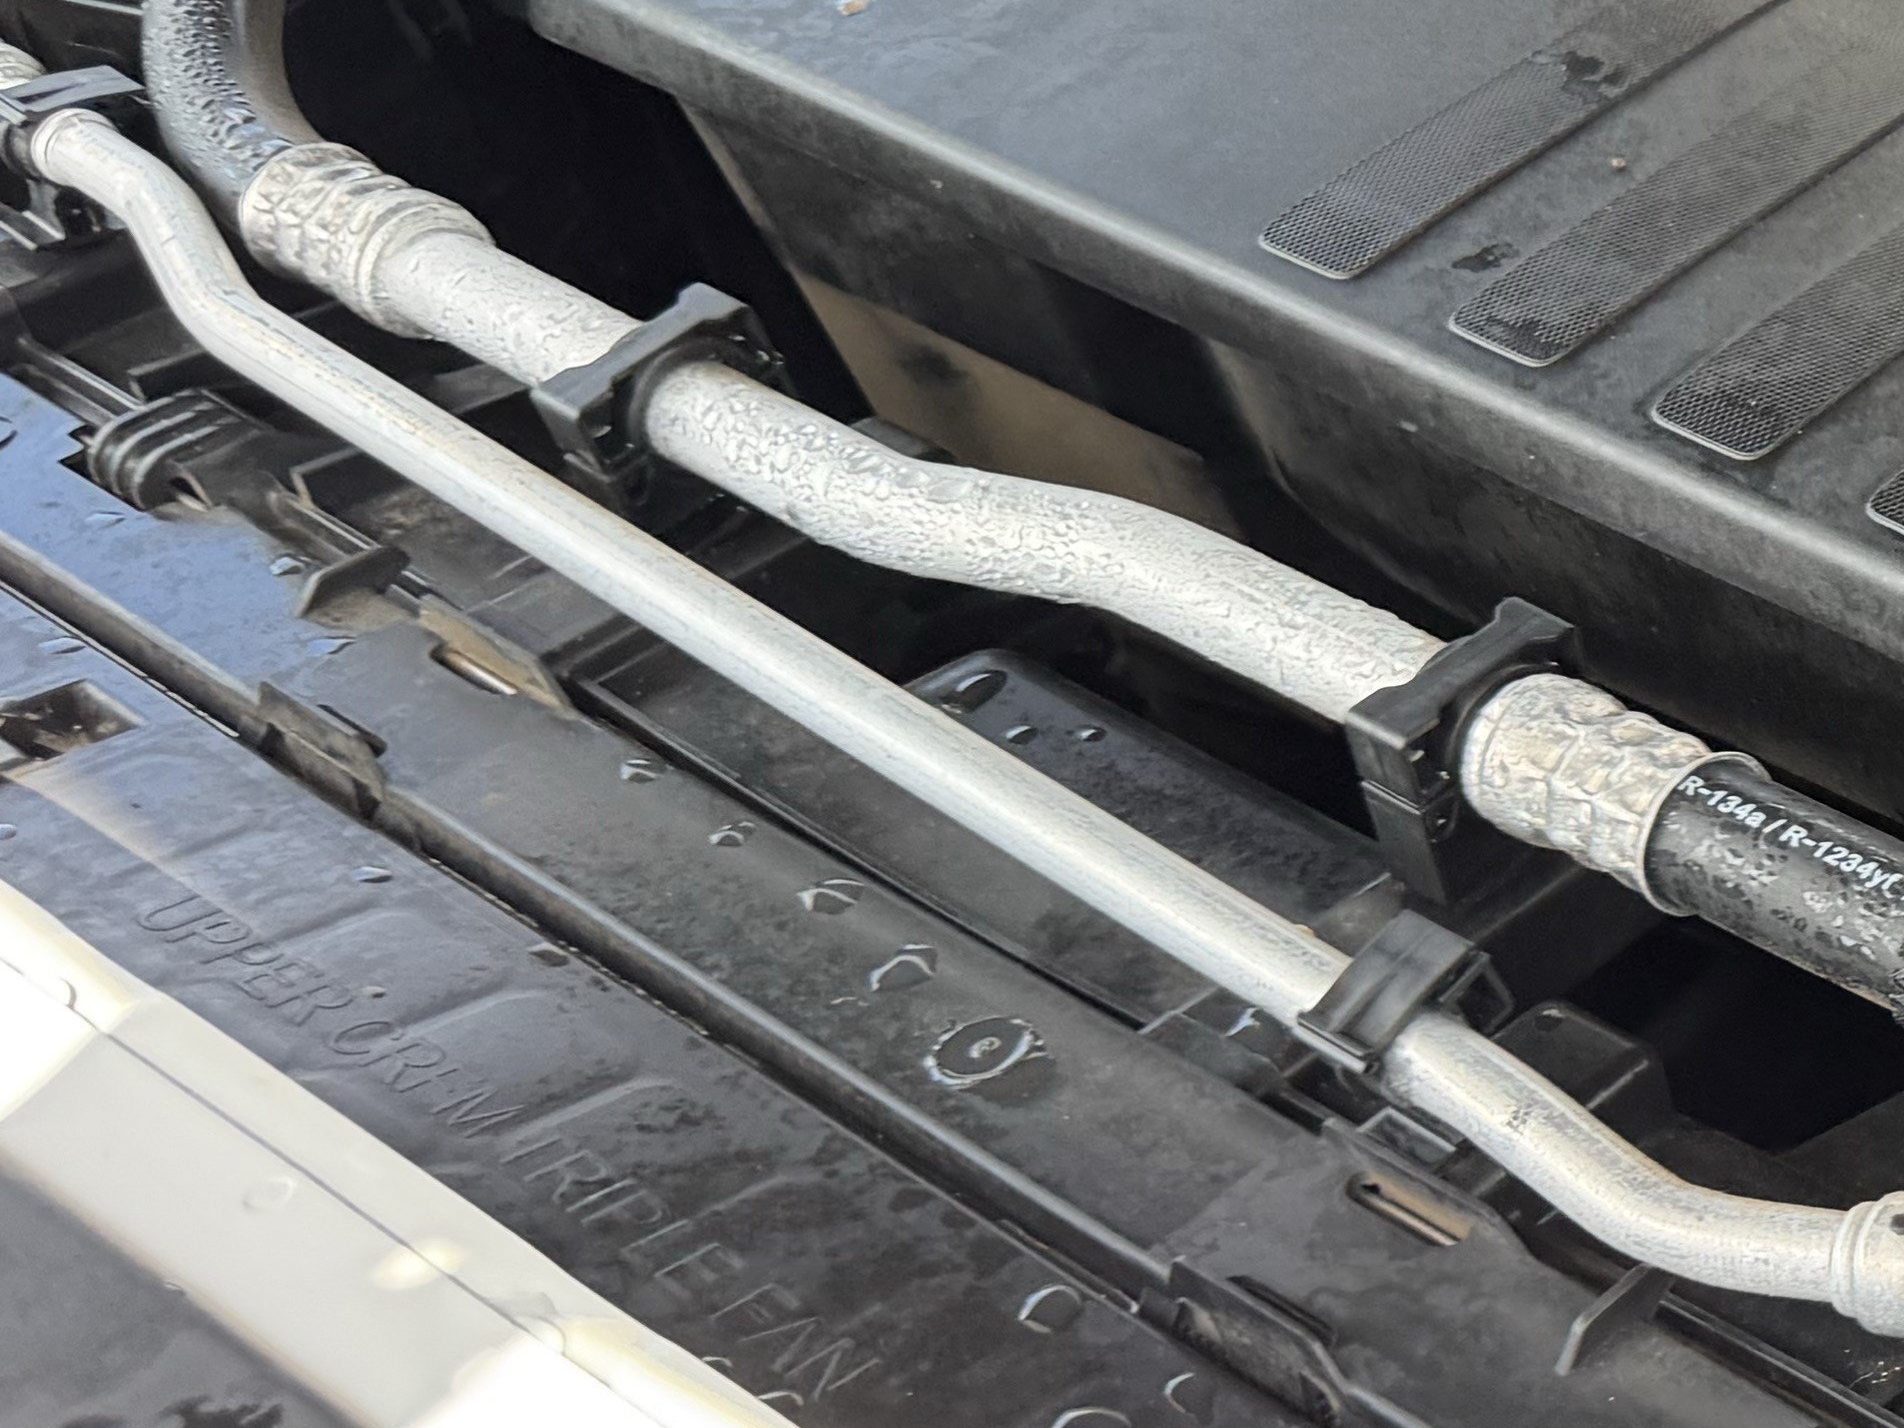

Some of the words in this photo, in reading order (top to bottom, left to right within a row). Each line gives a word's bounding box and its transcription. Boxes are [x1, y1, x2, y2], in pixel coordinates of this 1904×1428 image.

[1677, 775, 1767, 828] R-134a
[1762, 819, 1787, 834] /
[1779, 824, 1904, 892] R-1234yf
[136, 894, 354, 1027] UPPER
[708, 1282, 882, 1402] FAN
